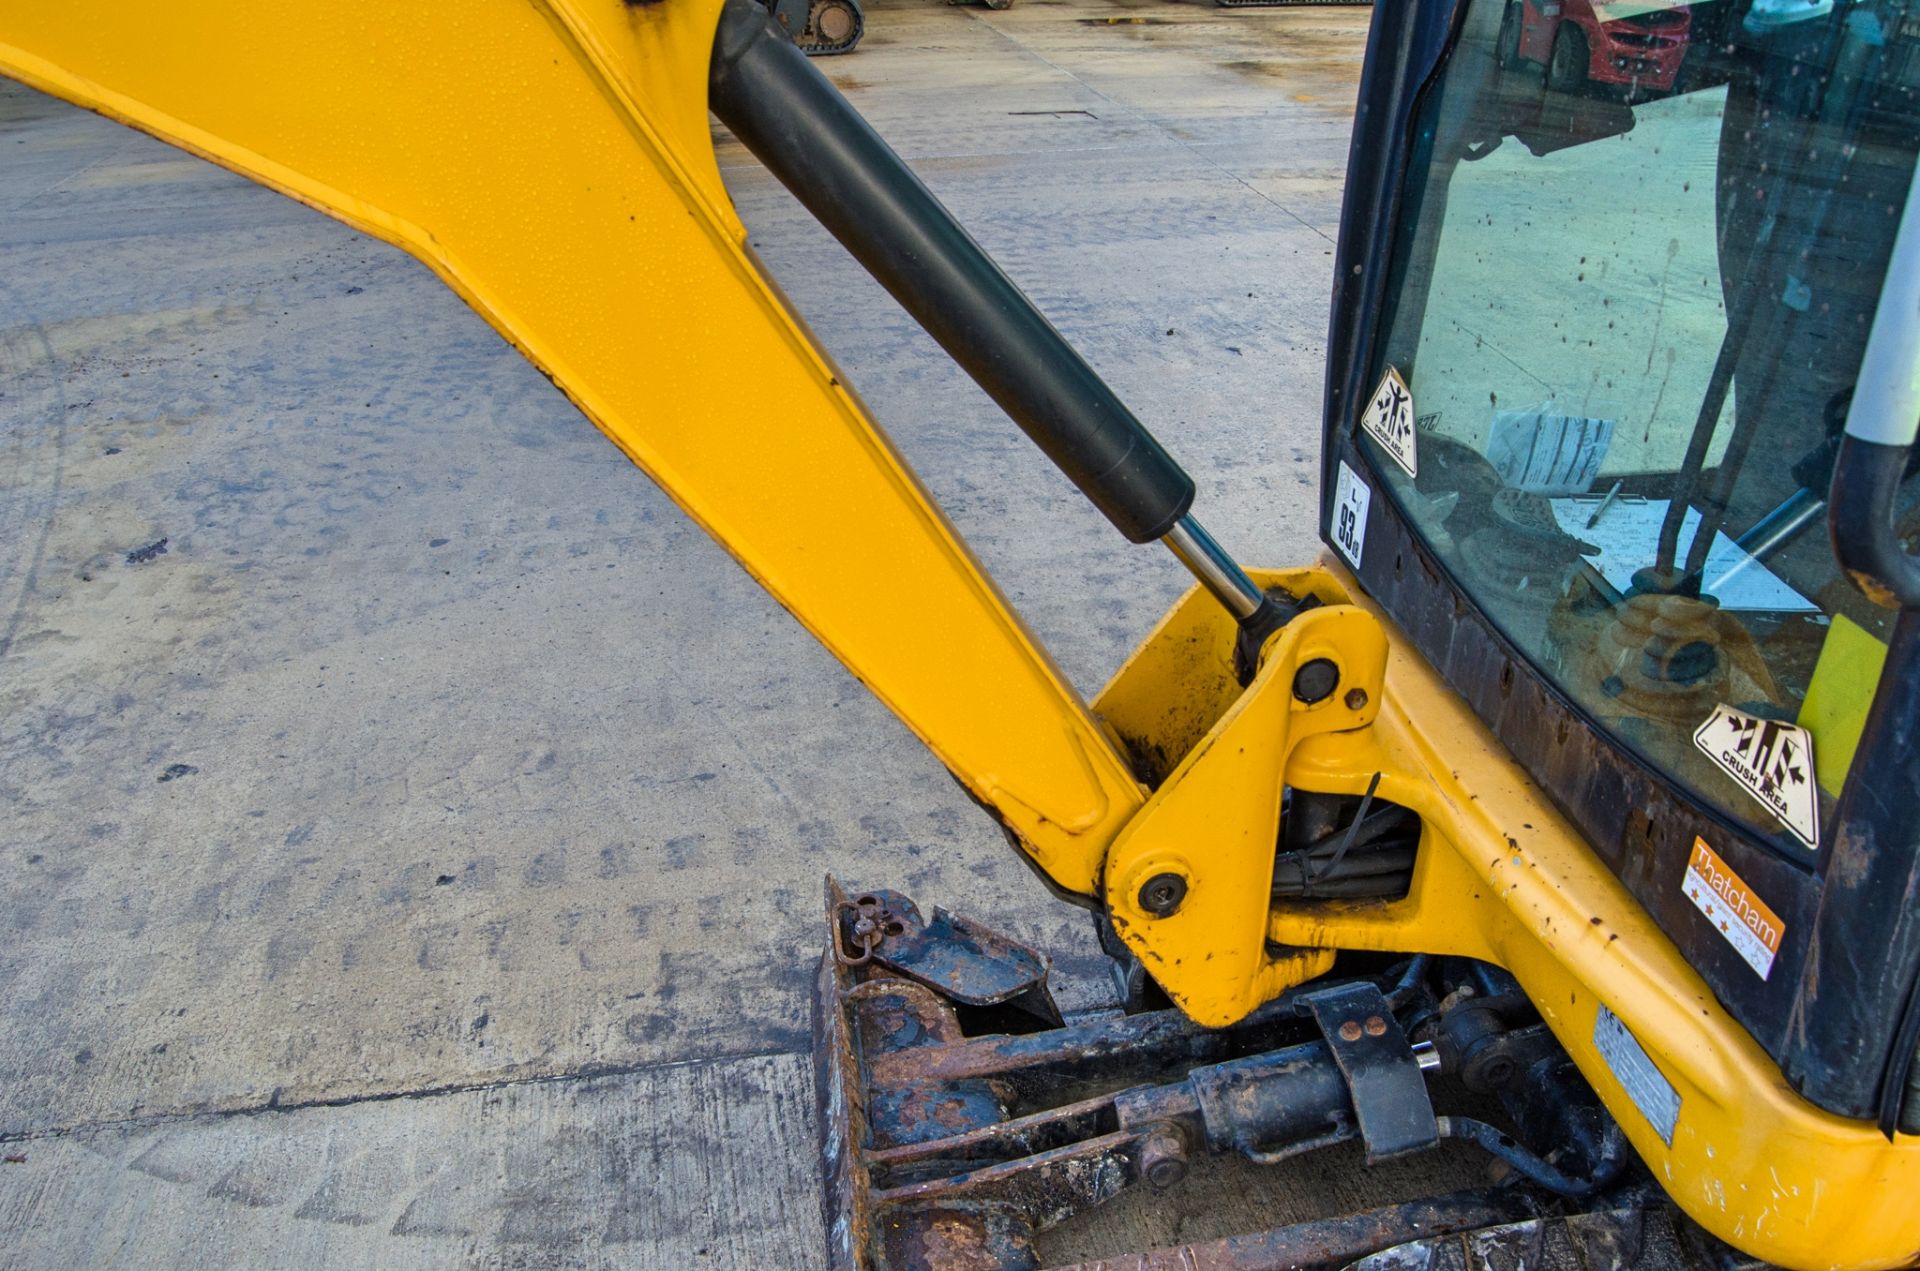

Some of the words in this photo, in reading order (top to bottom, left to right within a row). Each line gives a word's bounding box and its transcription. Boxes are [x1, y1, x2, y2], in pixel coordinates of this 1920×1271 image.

[1374, 424, 1391, 446] CRUSH
[1390, 440, 1404, 457] AREA
[1351, 488, 1357, 503] L
[1338, 503, 1356, 551] 93
[1722, 751, 1758, 786] CRUSH
[1759, 779, 1787, 814] AREA
[1698, 843, 1776, 948] Thatcham
